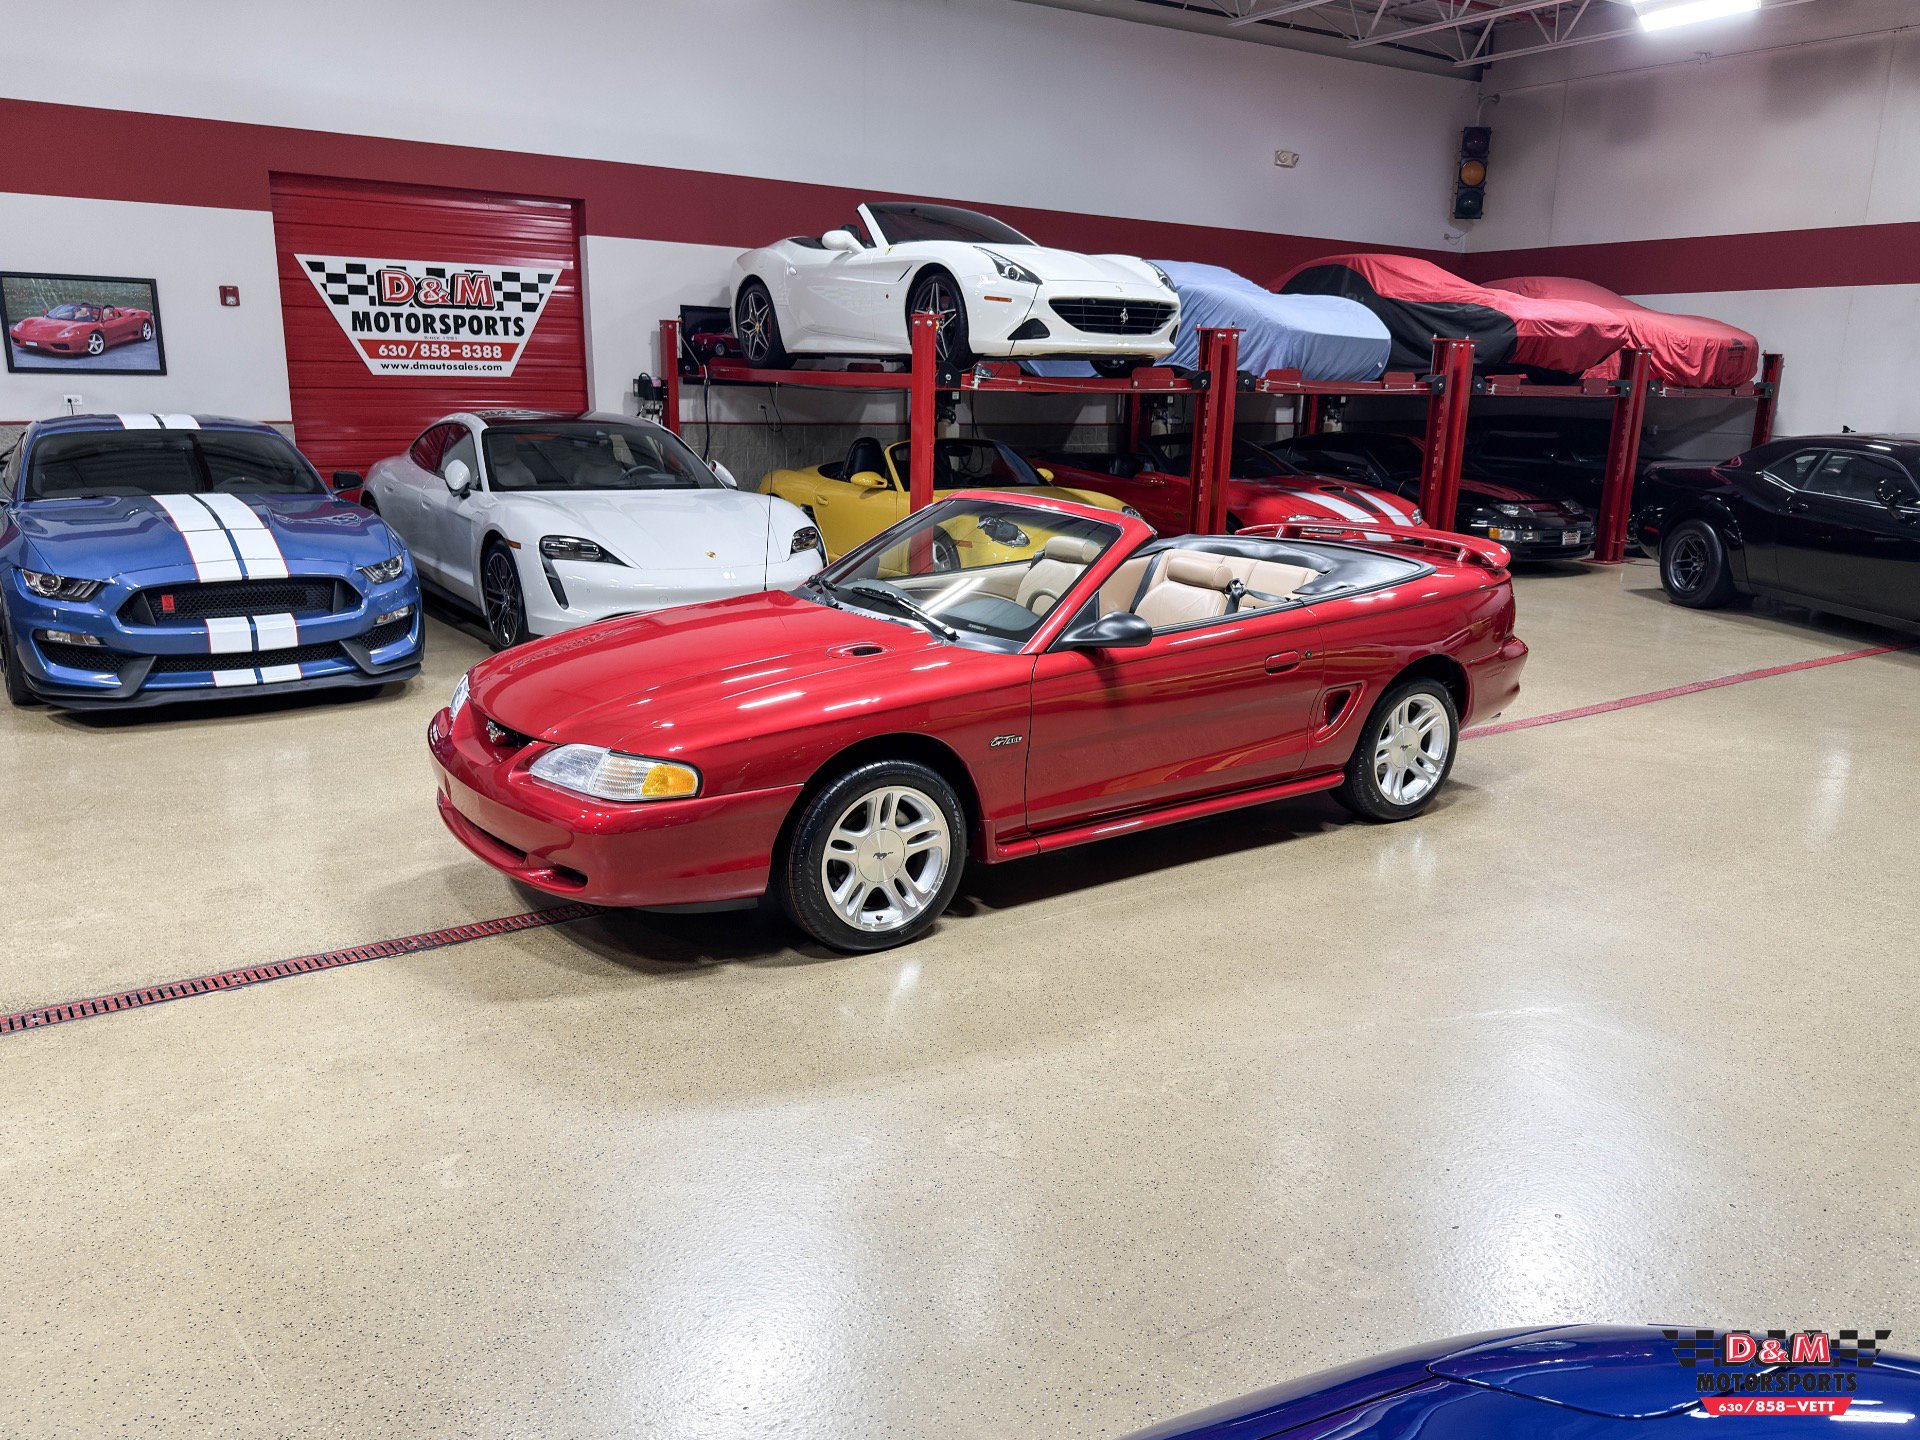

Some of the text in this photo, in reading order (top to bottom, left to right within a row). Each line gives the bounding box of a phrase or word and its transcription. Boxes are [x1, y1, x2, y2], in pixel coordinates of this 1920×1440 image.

[377, 269, 496, 309] D&M
[351, 311, 525, 336] MOTORSPORTS
[380, 361, 503, 371] www.dmautosales.com
